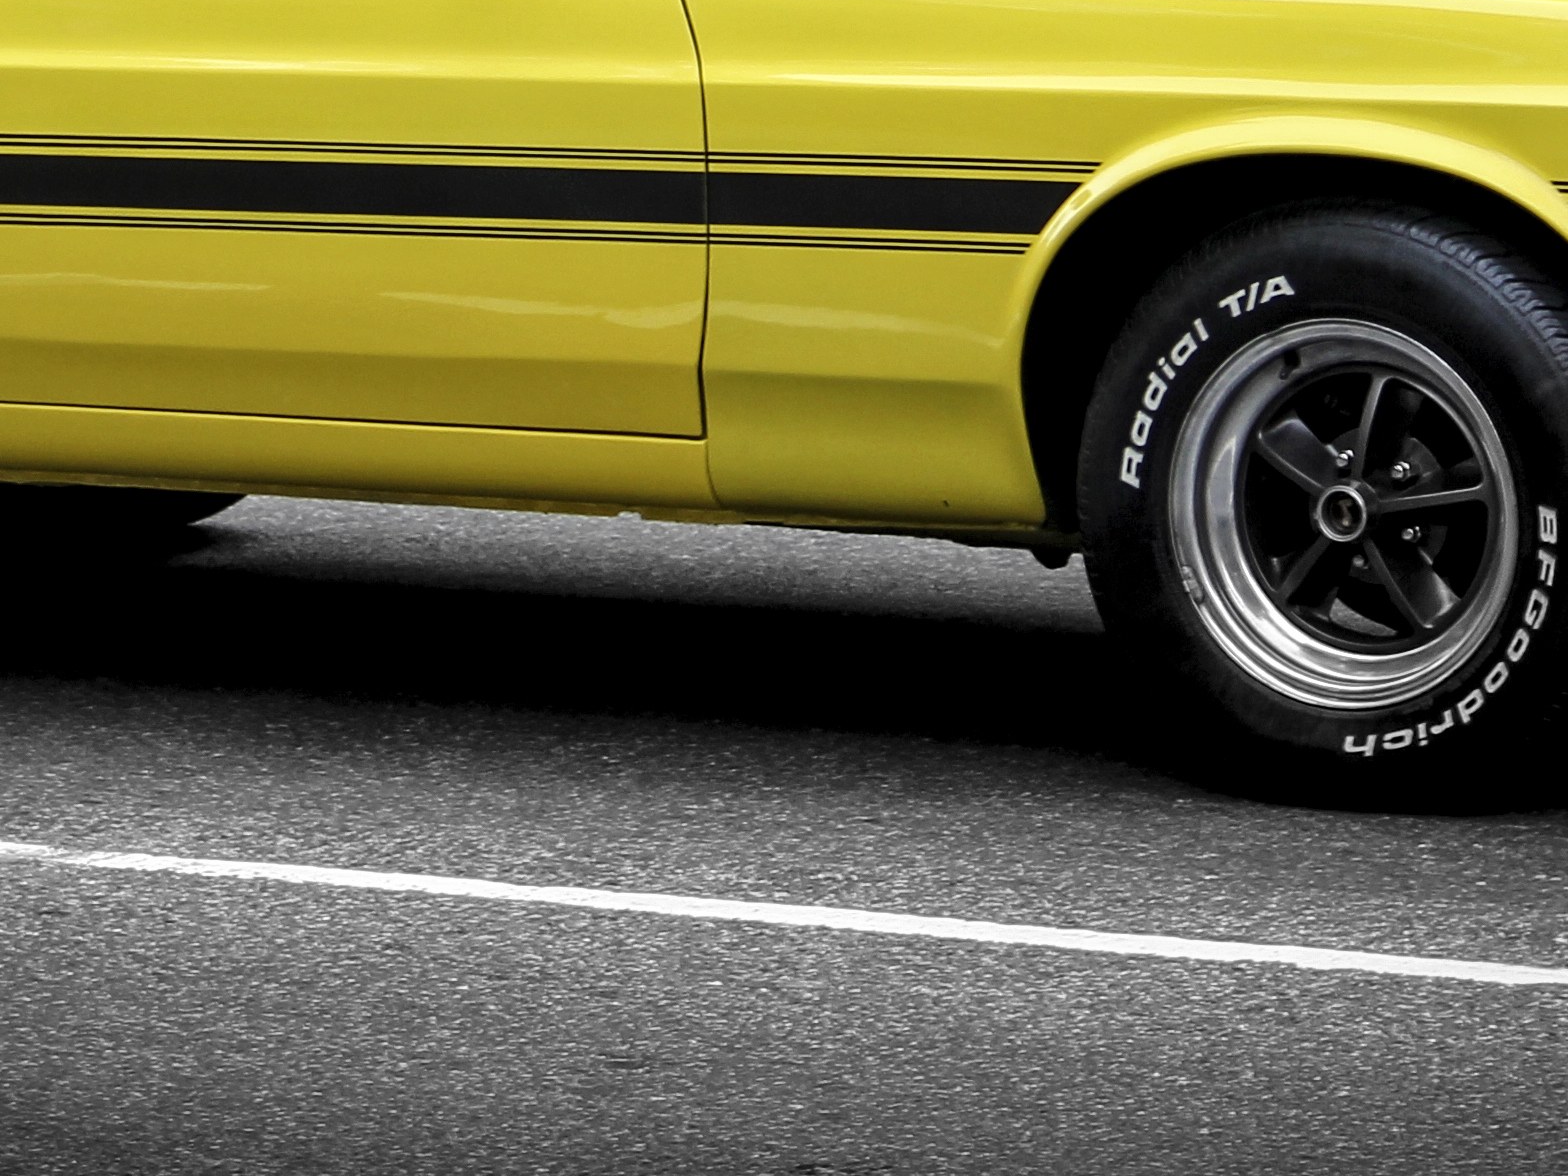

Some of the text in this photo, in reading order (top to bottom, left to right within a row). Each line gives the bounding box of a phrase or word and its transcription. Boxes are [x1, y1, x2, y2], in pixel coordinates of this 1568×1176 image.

[1119, 274, 1296, 489] Radial T/A
[1342, 504, 1559, 757] BFGoodrich
